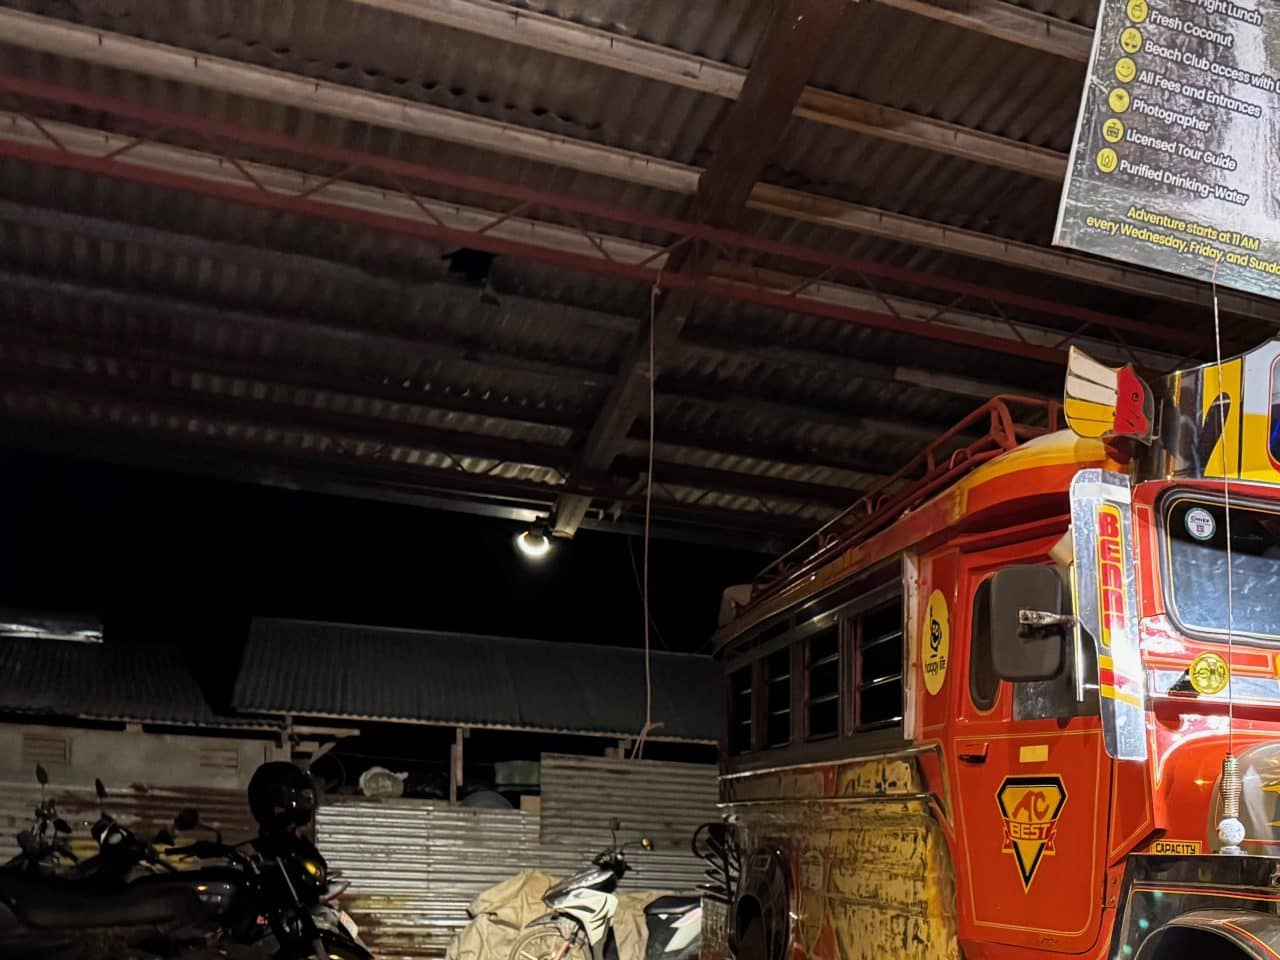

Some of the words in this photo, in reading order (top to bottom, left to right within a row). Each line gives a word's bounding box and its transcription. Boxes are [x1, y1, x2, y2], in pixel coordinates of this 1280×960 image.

[1151, 11, 1182, 30] Fresh
[1184, 22, 1233, 47] Coconut
[1228, 4, 1262, 25] Lunch
[1145, 41, 1181, 62] Beach
[1183, 52, 1209, 71] Club
[1211, 63, 1250, 86] access
[1250, 72, 1274, 91] with
[1138, 70, 1154, 86] All
[1155, 75, 1181, 94] Fees
[1182, 82, 1205, 99] and
[1206, 90, 1261, 118] Entrances
[1133, 99, 1211, 133] Photographer
[1126, 129, 1177, 155] Licensed
[1178, 140, 1203, 161] Tour
[1203, 149, 1236, 171] Guide
[1120, 159, 1163, 183] Purified
[1163, 170, 1249, 206] Drinking-Water
[1086, 215, 1118, 236] every
[1120, 221, 1188, 253] Wednesday,
[1189, 240, 1226, 262] Friday,
[1226, 248, 1249, 266] and
[1127, 206, 1185, 233] Adventure
[1187, 222, 1217, 241] starts
[1218, 229, 1231, 244] at
[1231, 231, 1241, 246] 11
[1240, 235, 1259, 250] AM
[925, 662, 938, 677] happy
[1009, 823, 1050, 839] BEST
[1155, 843, 1196, 855] CAPACITY
